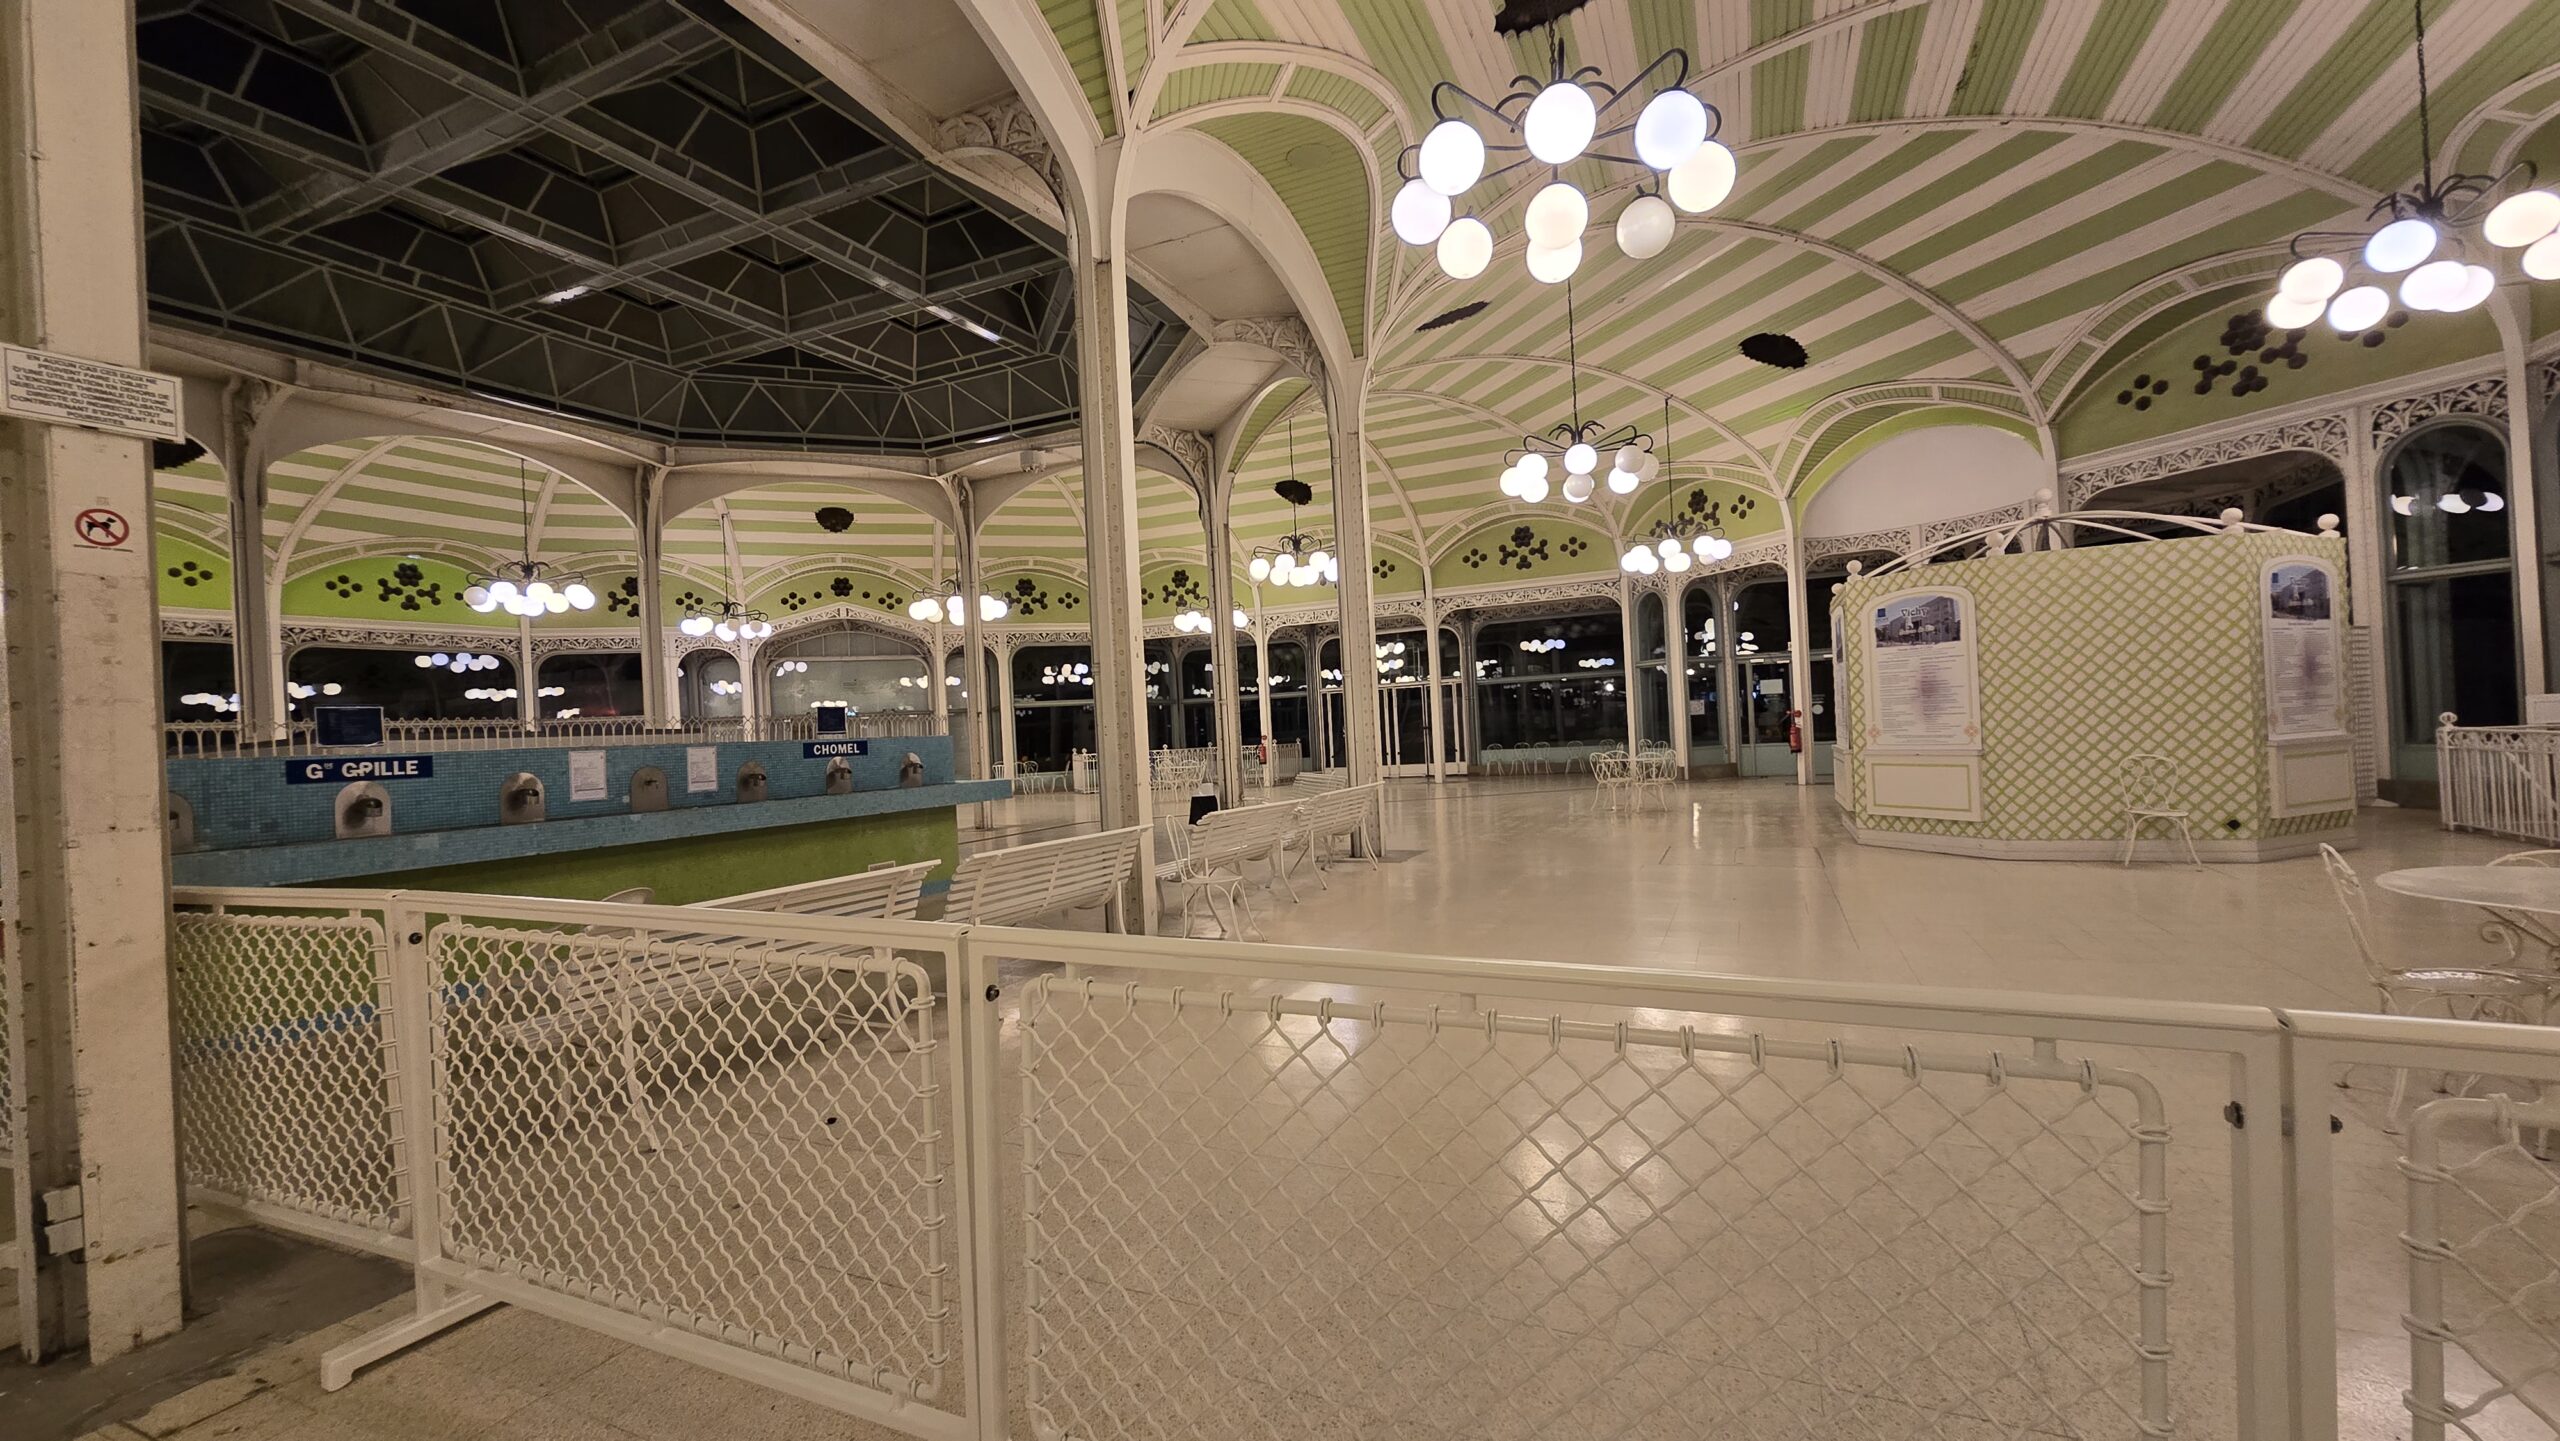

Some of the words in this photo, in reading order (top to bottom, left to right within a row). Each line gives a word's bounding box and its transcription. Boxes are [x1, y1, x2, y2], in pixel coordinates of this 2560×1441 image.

[38, 363, 81, 376] PEUVENT
[84, 372, 110, 382] FAIRE
[43, 357, 76, 368] AUCUN
[78, 364, 97, 373] CAS
[120, 372, 144, 382] EAUX
[12, 365, 43, 376] D'UNE
[46, 371, 103, 387] UTILISATION
[120, 386, 156, 397] DEHORS
[76, 384, 124, 398] THERMALE
[26, 390, 68, 402] DIRECTE
[139, 409, 160, 417] TOUT
[81, 392, 174, 413] COMMERCIALISATION
[813, 743, 860, 755] CHOMEL
[341, 760, 419, 778] GRILLE
